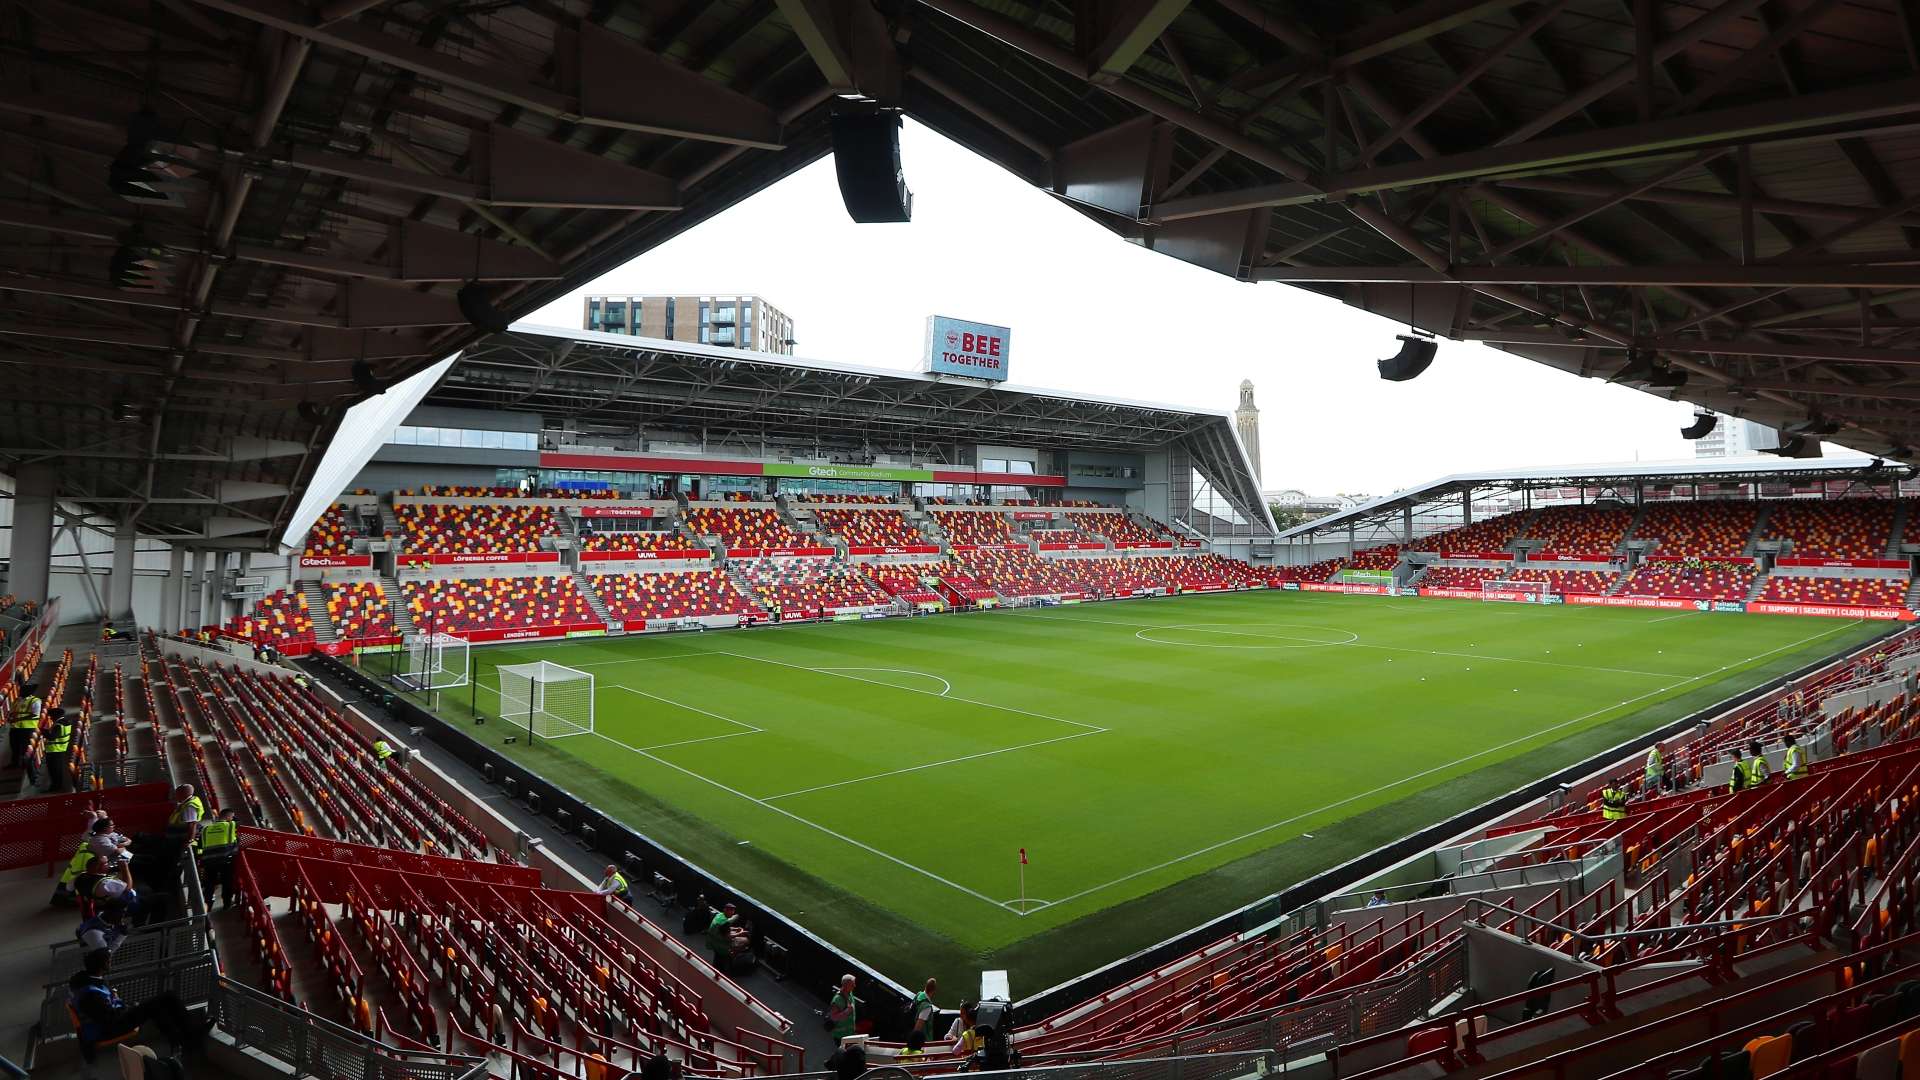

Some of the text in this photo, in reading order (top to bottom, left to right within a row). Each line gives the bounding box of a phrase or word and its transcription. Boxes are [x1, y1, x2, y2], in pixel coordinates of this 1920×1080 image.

[962, 332, 1001, 356] BEE
[942, 351, 1000, 369] TOGETHER
[808, 466, 837, 476] Gtech
[1767, 606, 1799, 614] SUPPORT
[1803, 608, 1836, 616] SECURITY
